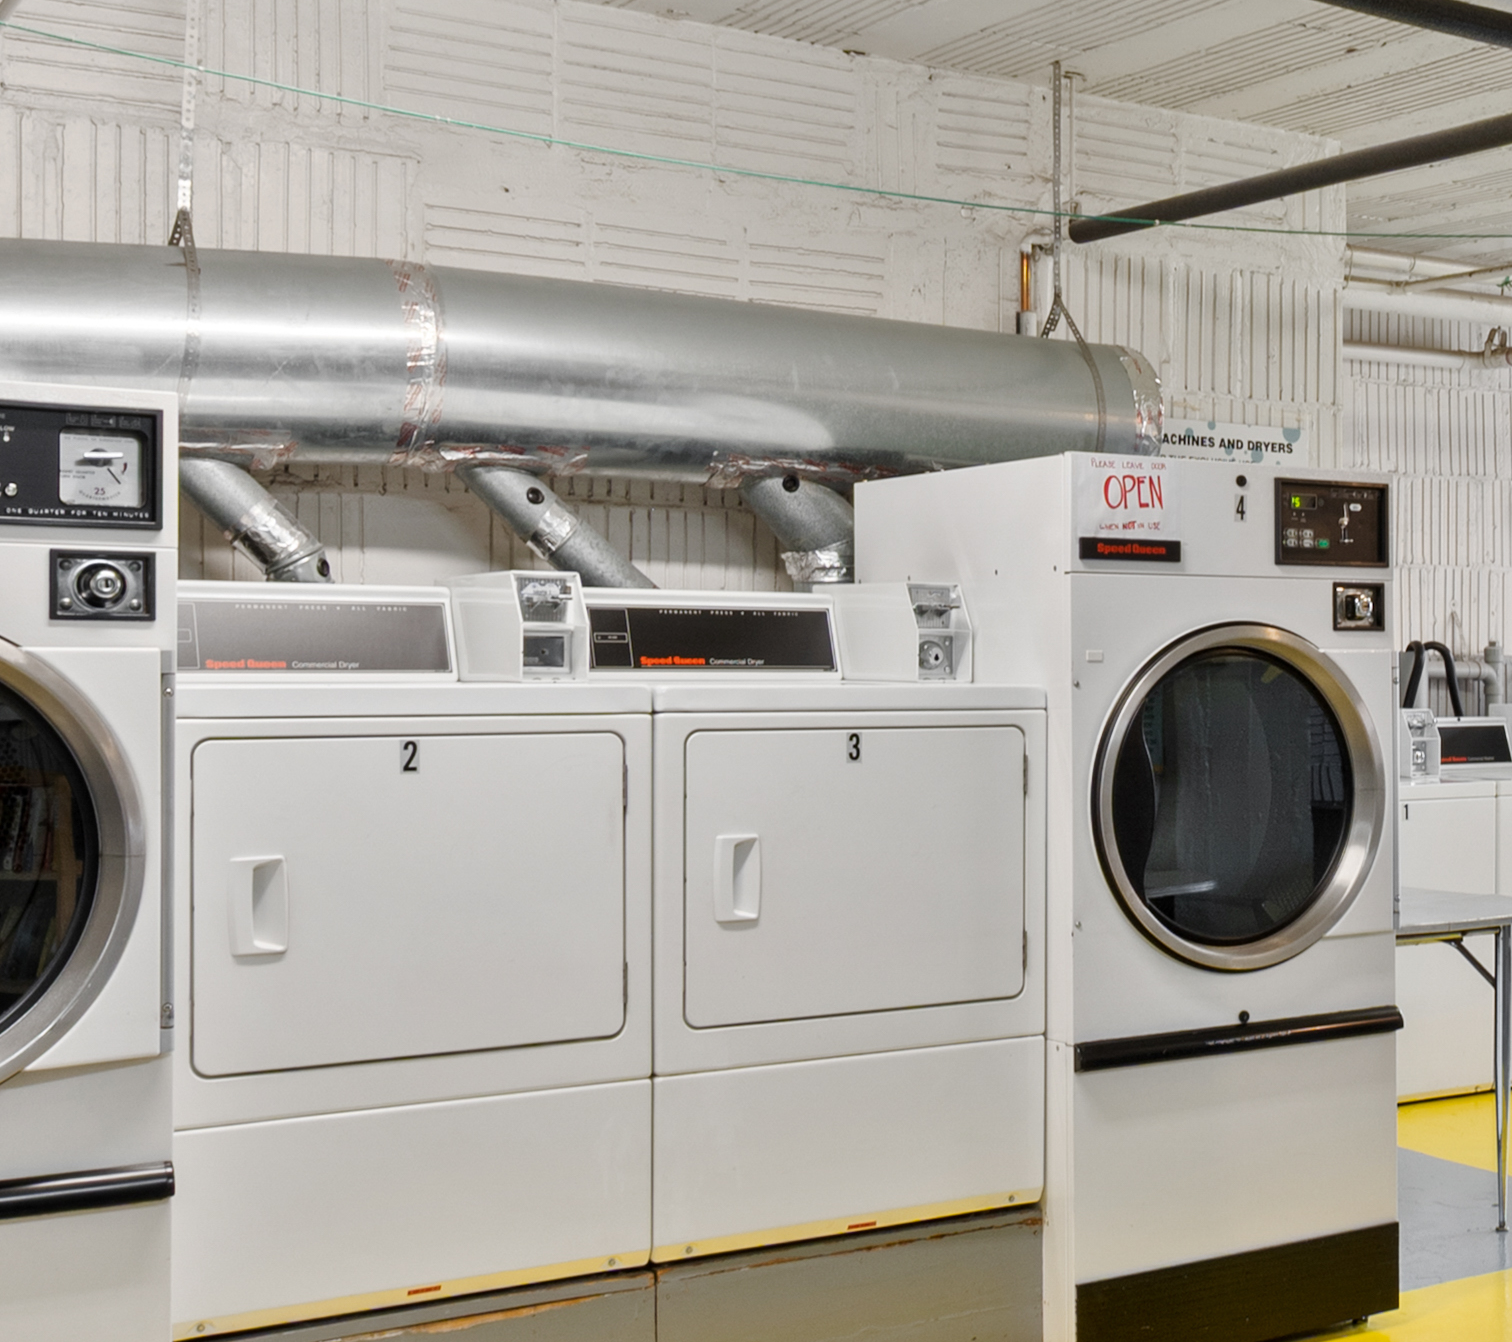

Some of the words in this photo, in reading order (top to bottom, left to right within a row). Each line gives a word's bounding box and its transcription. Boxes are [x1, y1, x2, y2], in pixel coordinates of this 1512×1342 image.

[0, 424, 15, 432] LOW
[1162, 433, 1216, 448] ACHINES
[1218, 438, 1244, 451] AND
[1246, 440, 1294, 455] DRYERS
[1090, 457, 1116, 469] PLEASE
[1121, 461, 1145, 470] LEAVE
[94, 487, 106, 496] 25
[1103, 474, 1164, 510] OPEN
[5, 507, 23, 515] ONE
[28, 508, 66, 516] QUARTER
[71, 509, 87, 517] FOR
[92, 510, 109, 518] TEN
[113, 511, 150, 519] MINUTES
[1236, 495, 1246, 521] 4
[1122, 520, 1137, 530] NOT
[1148, 521, 1161, 531] USE
[1097, 543, 1131, 555] Speed
[1132, 544, 1166, 555] Queen
[205, 659, 245, 670] Speed
[247, 659, 287, 669] Queen
[291, 660, 338, 669] Commercial
[339, 661, 360, 671] Dryer
[639, 656, 673, 667] Speed
[673, 656, 706, 666] Queen
[709, 657, 747, 665] Commercial
[748, 658, 765, 667] Dryer
[848, 733, 861, 761] 3
[403, 742, 418, 772] 2
[1404, 803, 1409, 821] 1
